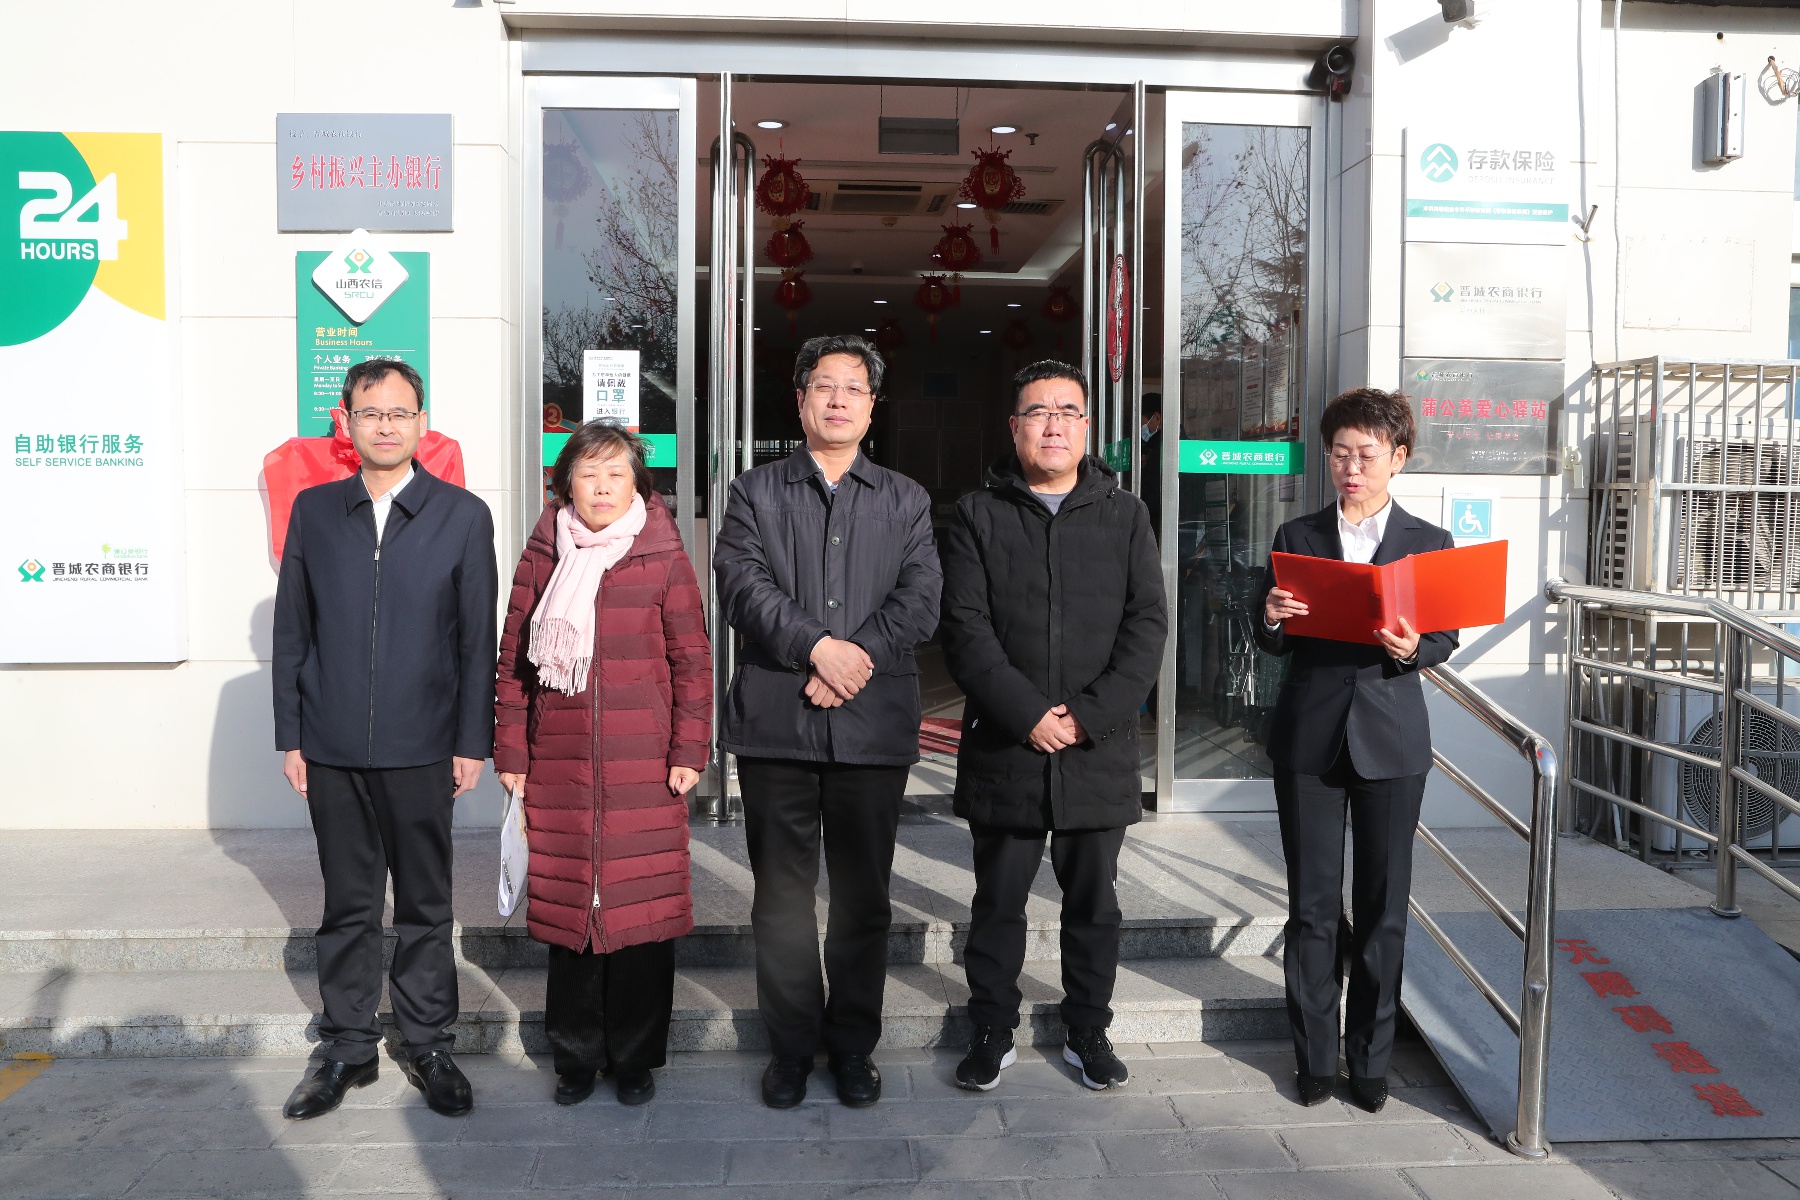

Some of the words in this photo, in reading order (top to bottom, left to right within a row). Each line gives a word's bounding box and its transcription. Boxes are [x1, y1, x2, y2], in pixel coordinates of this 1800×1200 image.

[1467, 148, 1556, 172] 存款保险
[290, 154, 442, 191] 乡村振兴主办银行
[18, 171, 128, 261] 24
[20, 242, 96, 260] HOURS
[335, 278, 383, 289] 山西农信
[344, 291, 375, 299] SRCU
[1459, 285, 1543, 299] 晋城农商银行
[315, 327, 359, 338] 营业时间
[313, 354, 351, 364] 个人业务
[596, 388, 626, 403] 口罩
[547, 409, 558, 419] 2
[1421, 397, 1547, 420] 蒲公英爱心驿站
[15, 433, 144, 454] 自助银行服务
[15, 457, 42, 467] SELF
[45, 457, 92, 467] SERVICE
[95, 457, 144, 467] BANKING
[1221, 451, 1285, 462] 晋城农商银行
[52, 562, 149, 575] 晋城农商银行
